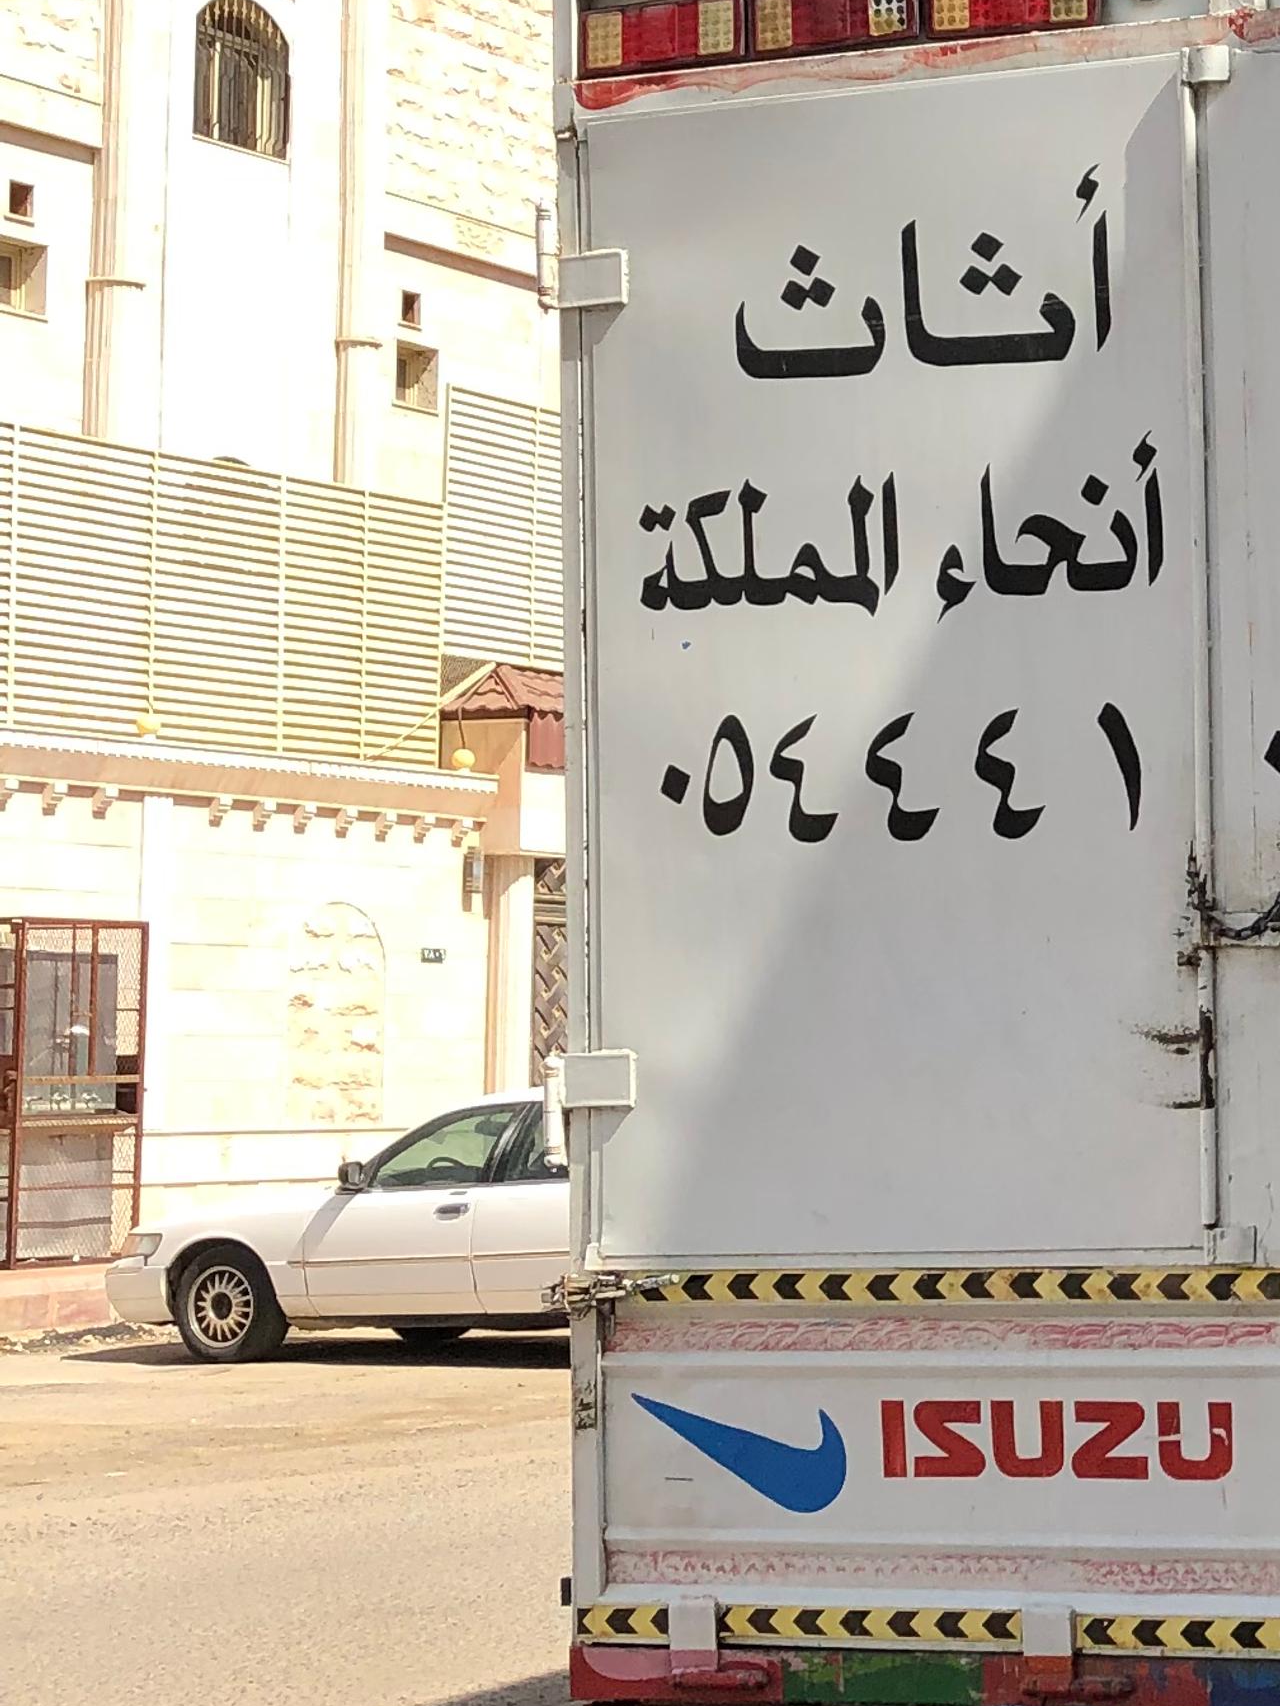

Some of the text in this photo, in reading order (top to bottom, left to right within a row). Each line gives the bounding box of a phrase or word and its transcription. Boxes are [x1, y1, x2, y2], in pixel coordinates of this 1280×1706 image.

[735, 164, 1112, 380] أثاث
[639, 471, 899, 616] المملكة
[936, 430, 1164, 622] أنحاء
[880, 1398, 1233, 1481] ISUZU
